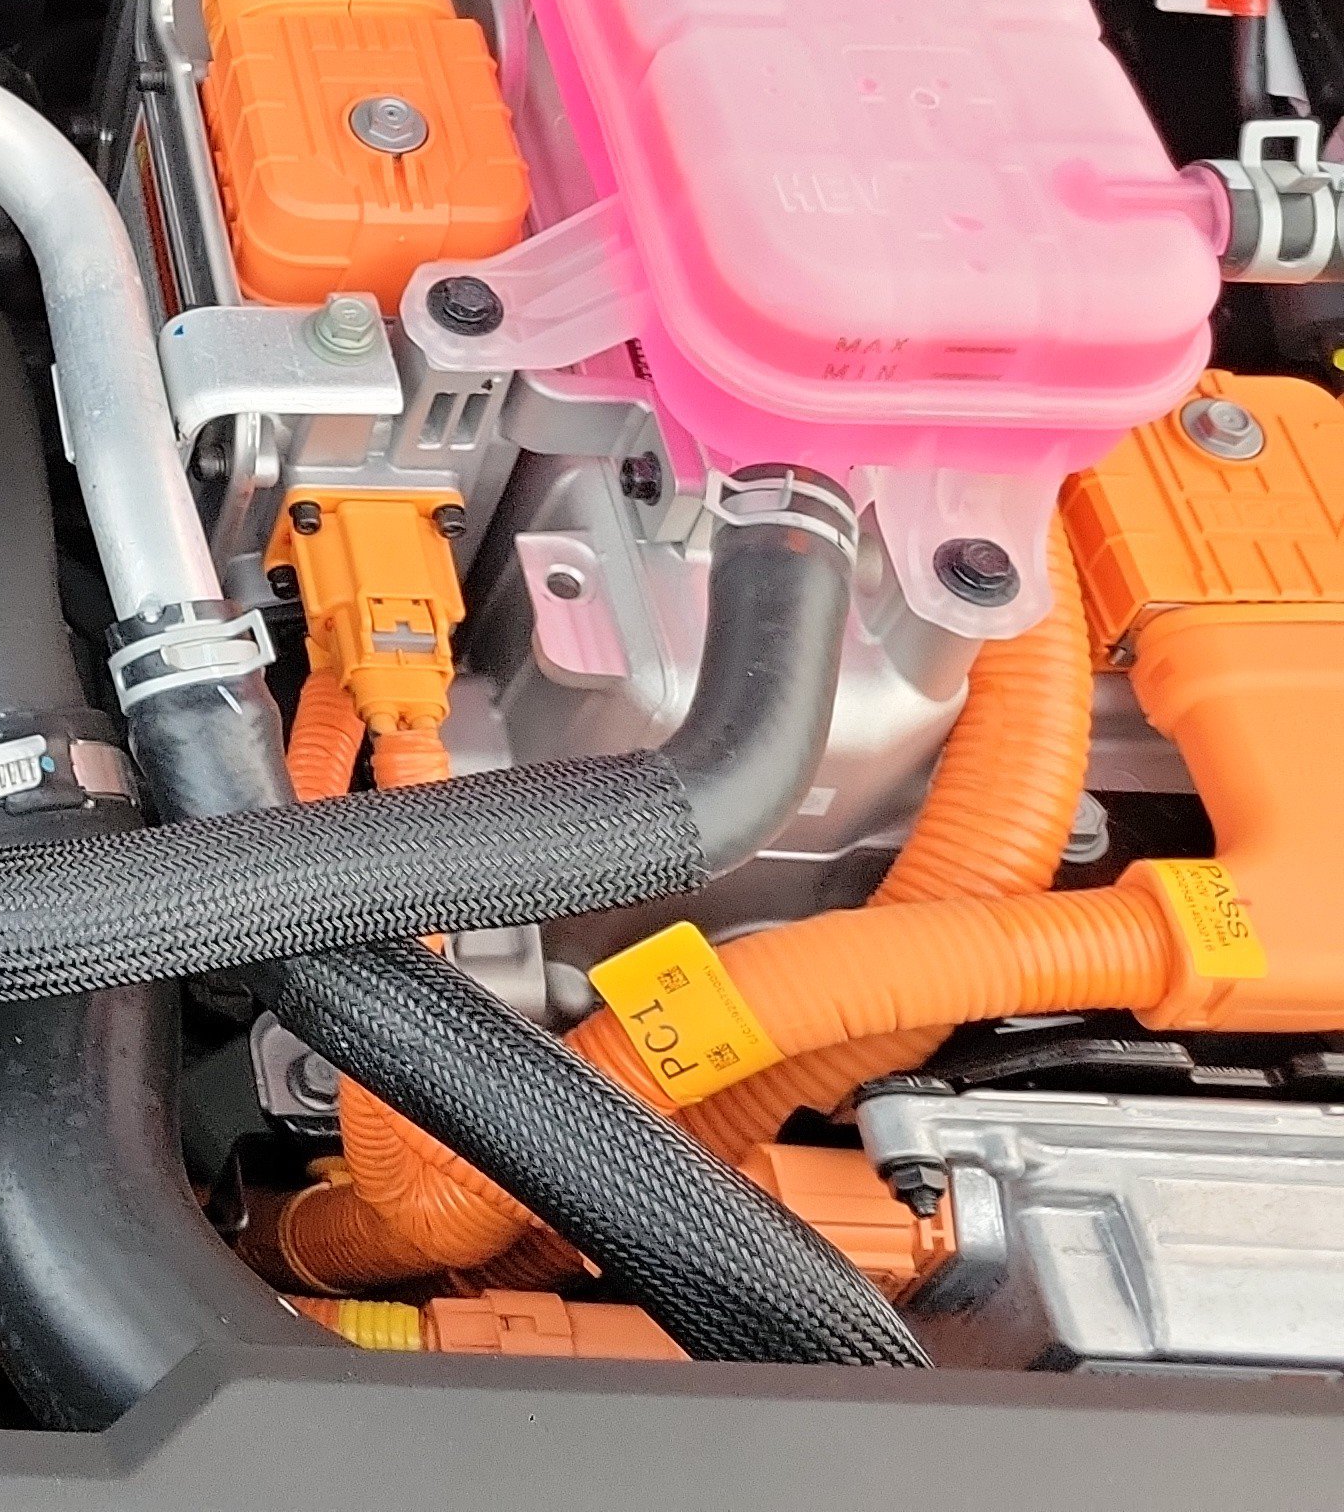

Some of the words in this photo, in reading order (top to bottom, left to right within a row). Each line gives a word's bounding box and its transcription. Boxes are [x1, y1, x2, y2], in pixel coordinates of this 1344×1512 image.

[834, 337, 910, 354] MAX
[822, 363, 898, 380] MIN
[1199, 866, 1250, 939] PASS
[629, 998, 699, 1081] PC1
